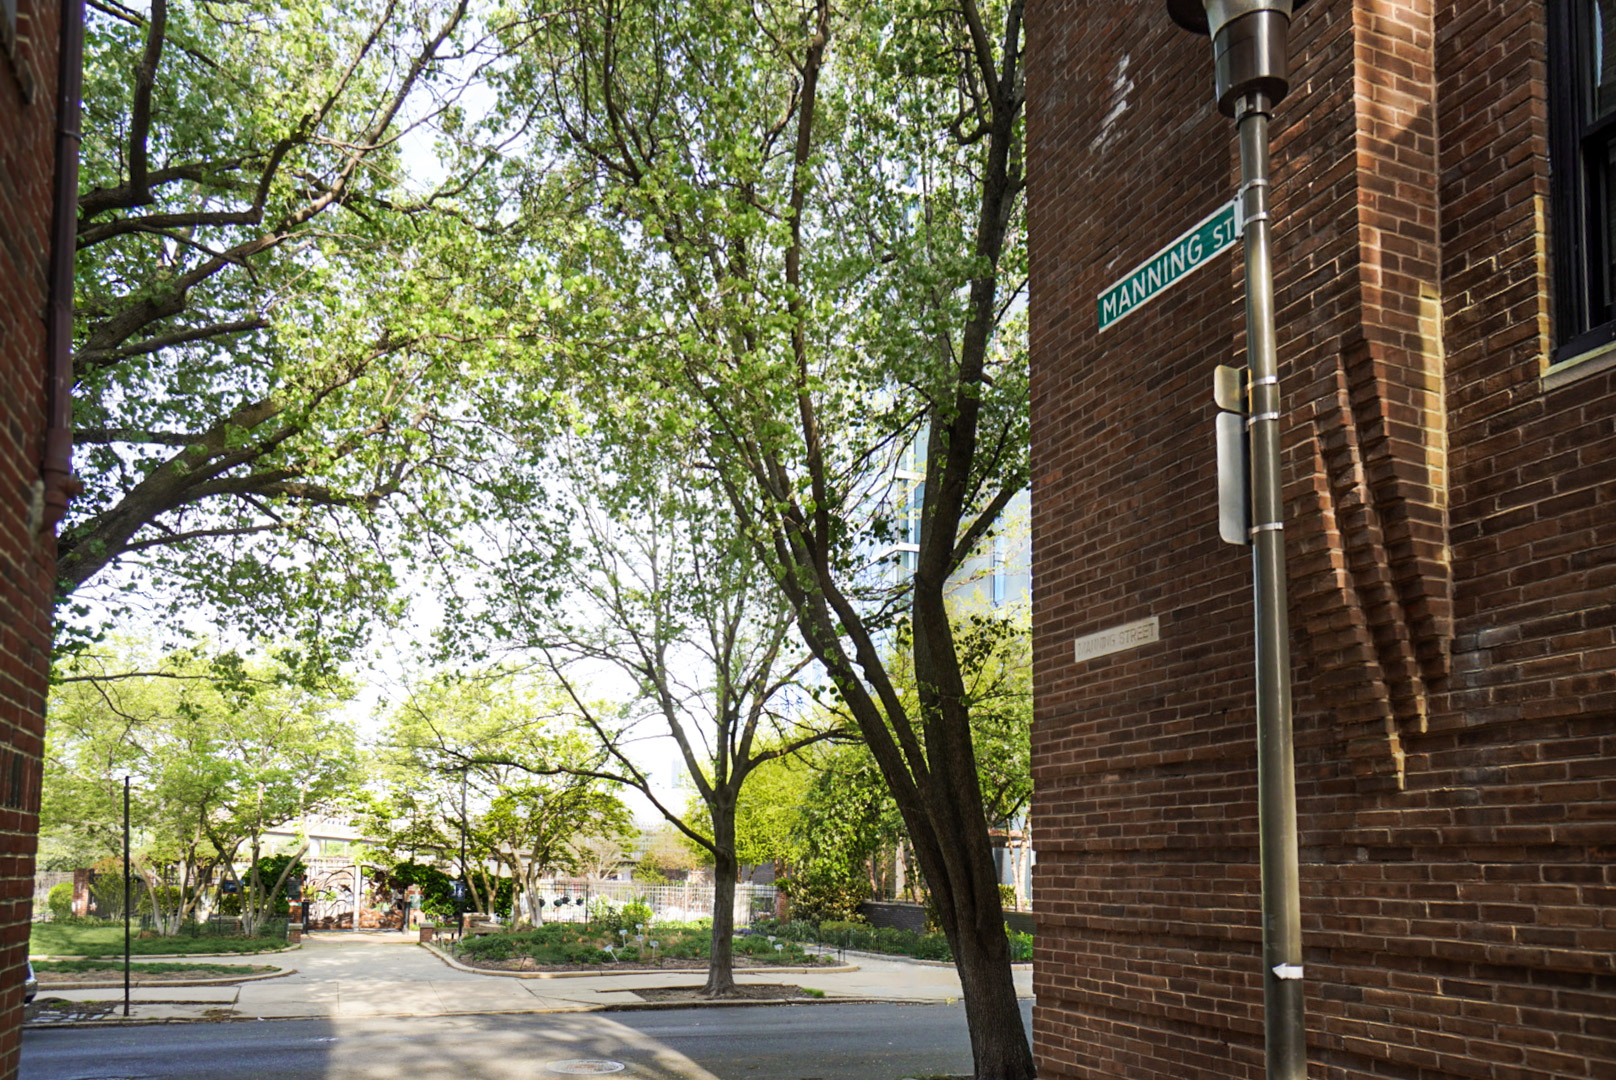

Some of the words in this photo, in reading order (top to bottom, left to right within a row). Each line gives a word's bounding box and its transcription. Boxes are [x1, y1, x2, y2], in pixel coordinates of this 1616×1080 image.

[1102, 234, 1203, 324] MANNING
[1213, 216, 1234, 249] ST
[1118, 622, 1155, 645] STREET
